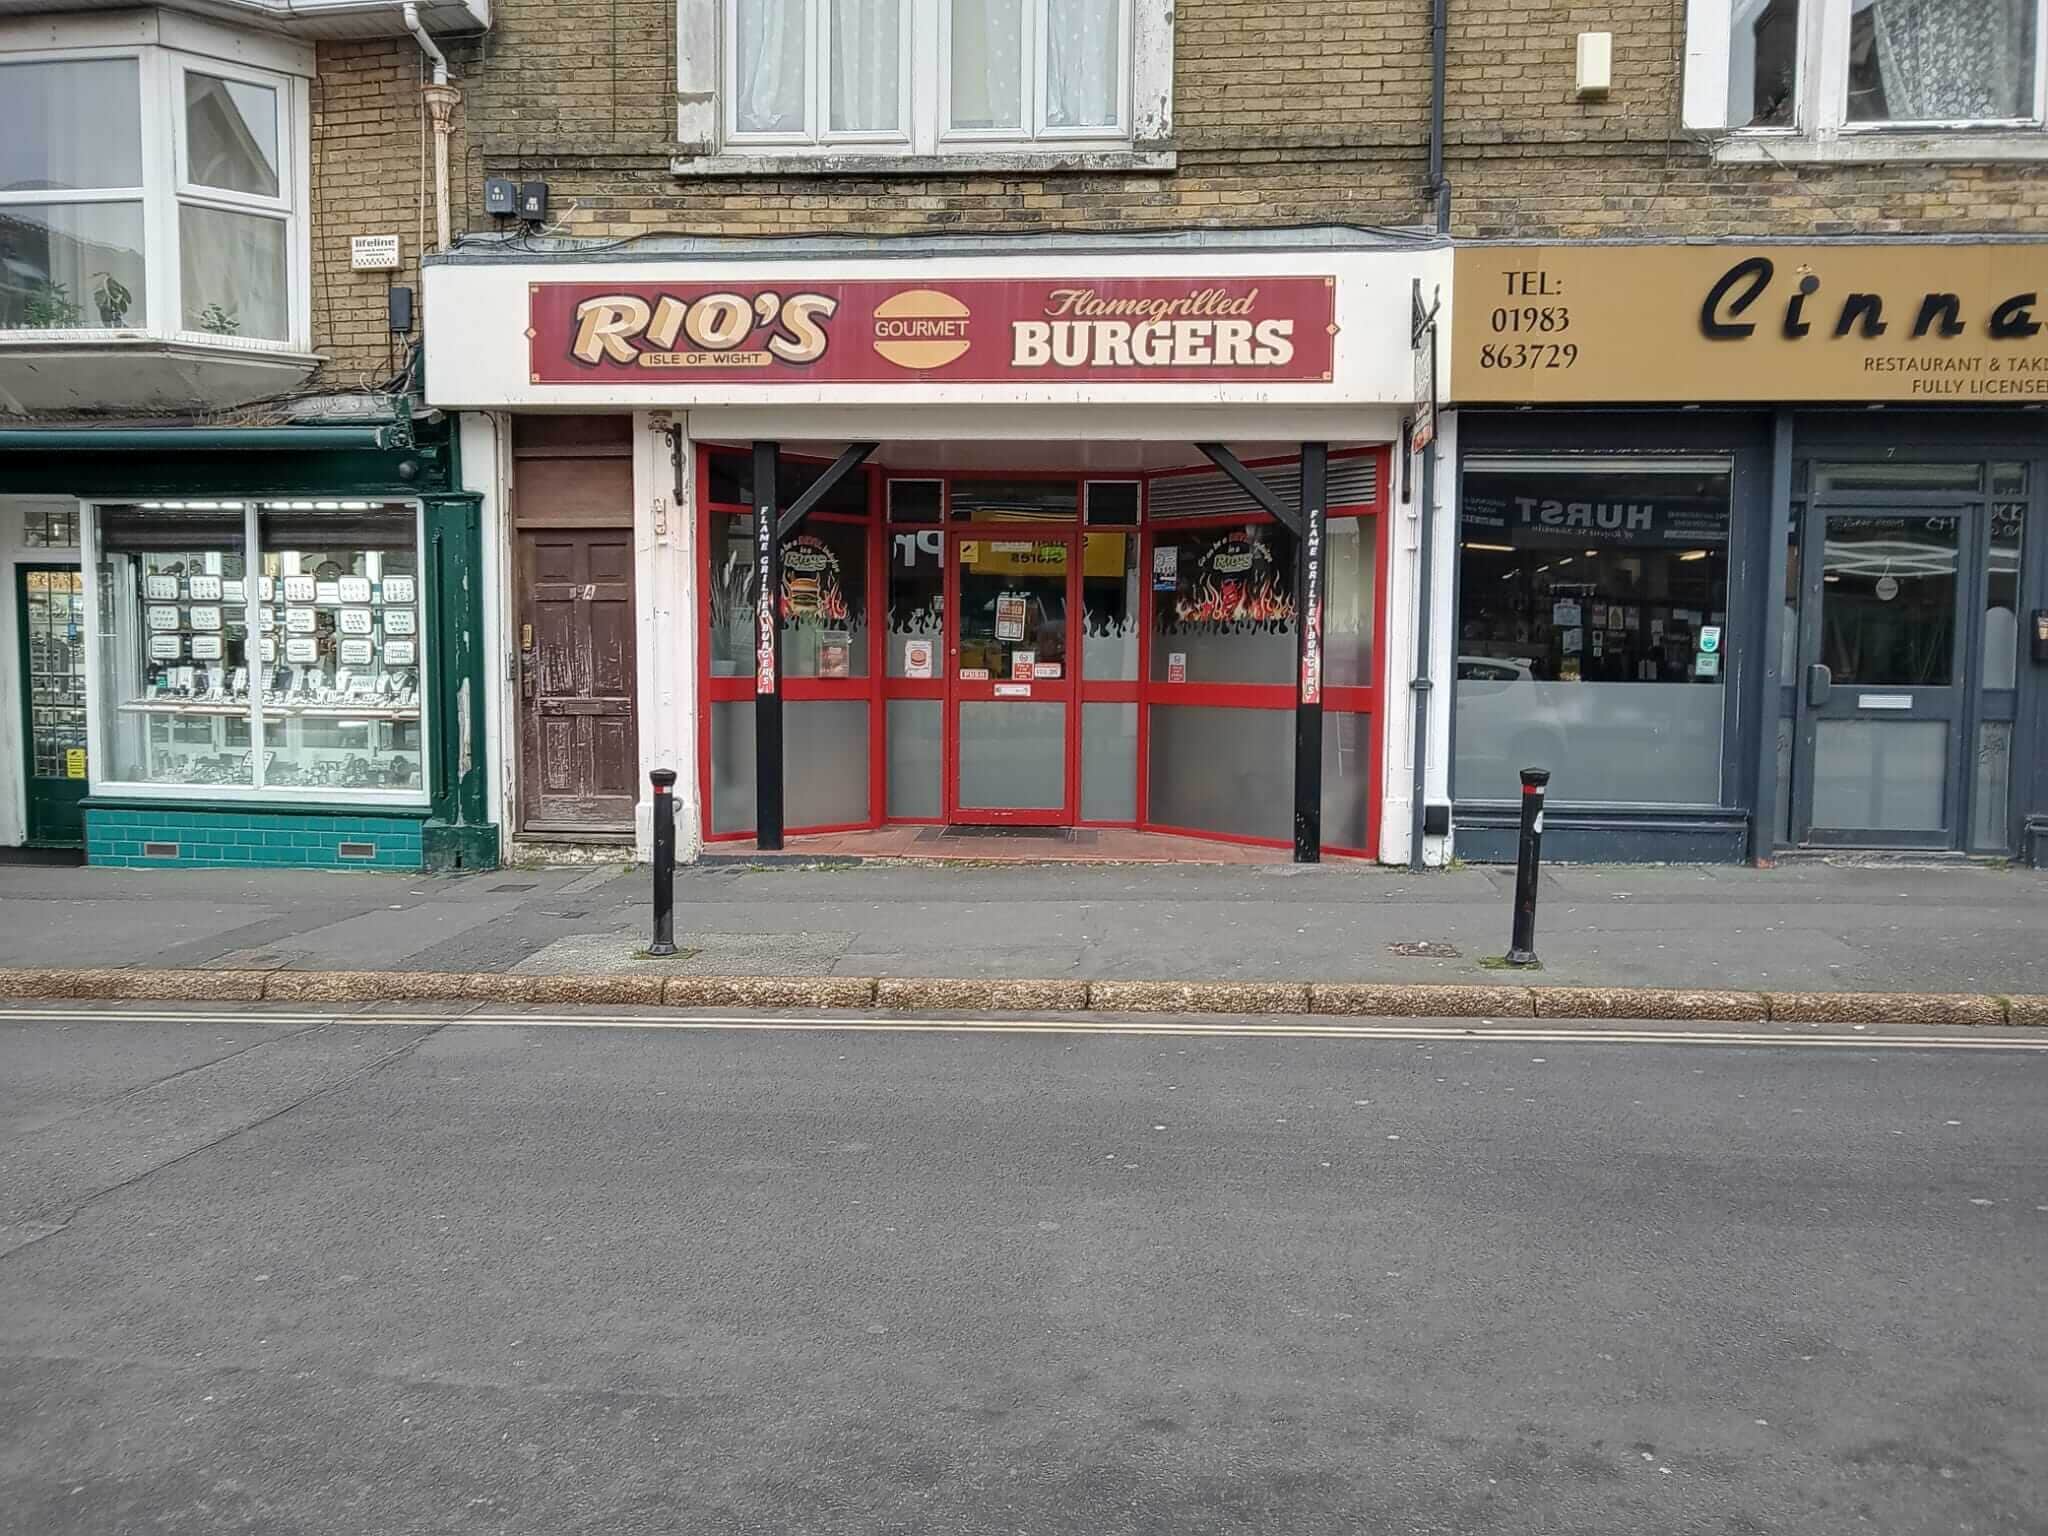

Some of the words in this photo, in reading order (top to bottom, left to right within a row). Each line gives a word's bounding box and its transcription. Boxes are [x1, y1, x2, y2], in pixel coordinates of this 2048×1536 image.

[355, 238, 396, 247] lifeline
[1501, 271, 1562, 296] TEL:
[1043, 287, 1260, 324] Flamegrilled
[571, 292, 839, 367] RIO'S
[874, 320, 970, 338] GOURMET
[1491, 306, 1570, 333] 01983
[1011, 319, 1296, 368] BURGERS
[1480, 343, 1579, 370] 863729
[649, 354, 681, 365] ISLE
[686, 353, 708, 365] OF
[712, 352, 762, 364] WIGHT
[1864, 356, 1982, 372] RESTAURANT
[1989, 357, 2001, 372] &
[1912, 379, 1964, 394] FULLY
[1969, 379, 2048, 394] LICENSE
[759, 506, 771, 552] FLAME
[1308, 509, 1320, 556] FLAME
